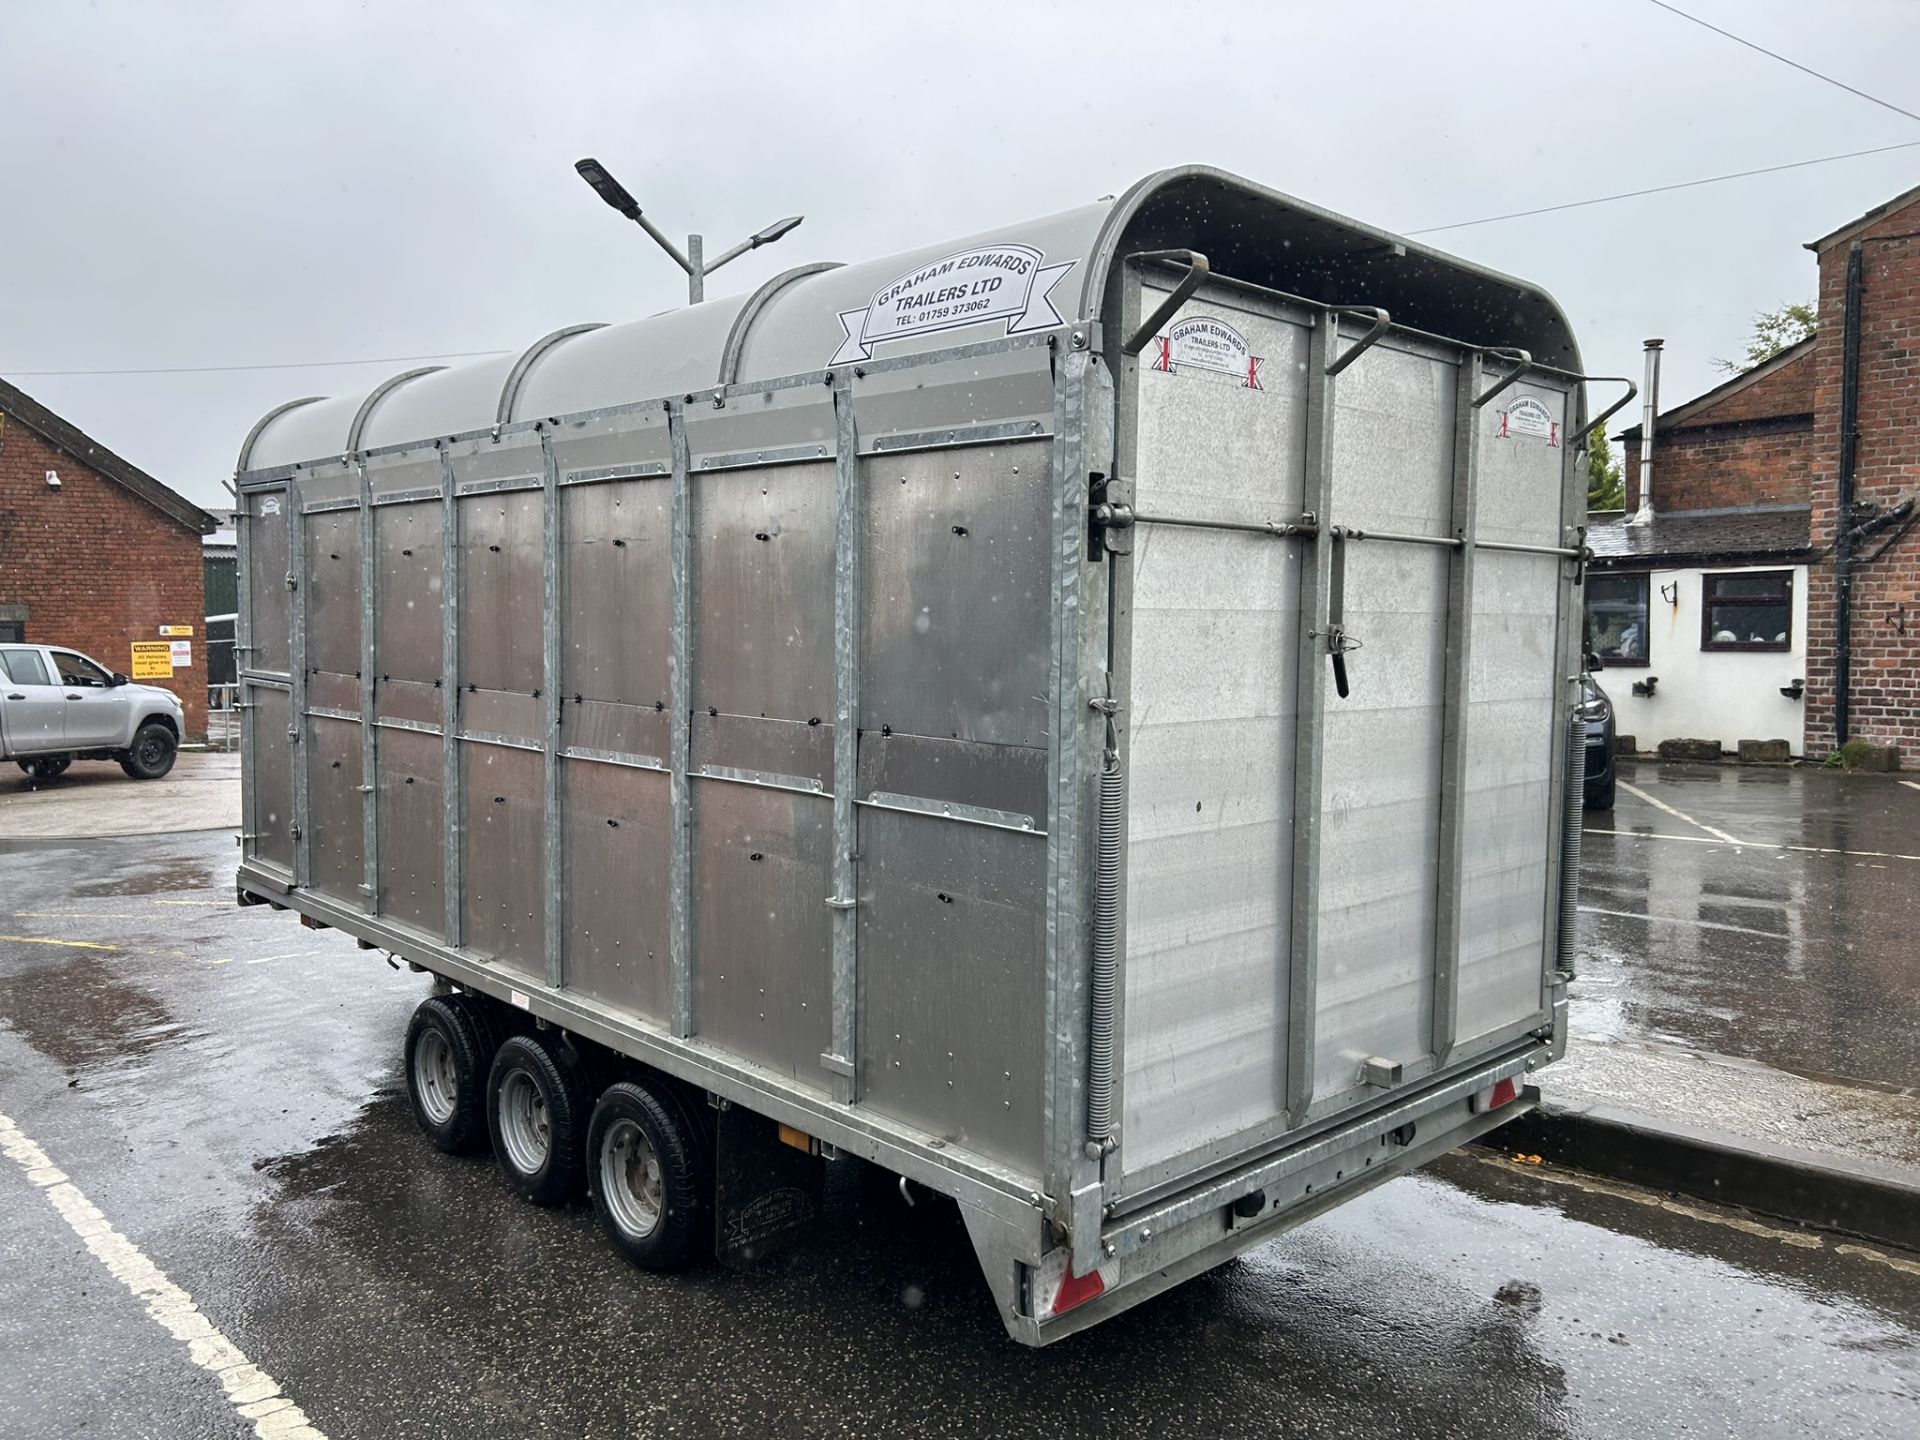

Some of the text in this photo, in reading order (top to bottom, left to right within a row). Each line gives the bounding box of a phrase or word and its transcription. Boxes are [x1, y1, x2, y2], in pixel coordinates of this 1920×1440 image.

[878, 253, 1032, 307] GRAHAM EDWARDS
[895, 276, 1003, 312] TRAILERS LTD
[896, 299, 990, 326] TEL: 01759 373062
[1173, 323, 1208, 341] GRAHAM
[1210, 325, 1247, 356] EDWARDS
[1191, 336, 1219, 349] TRAILERS
[1219, 343, 1231, 352] LTD
